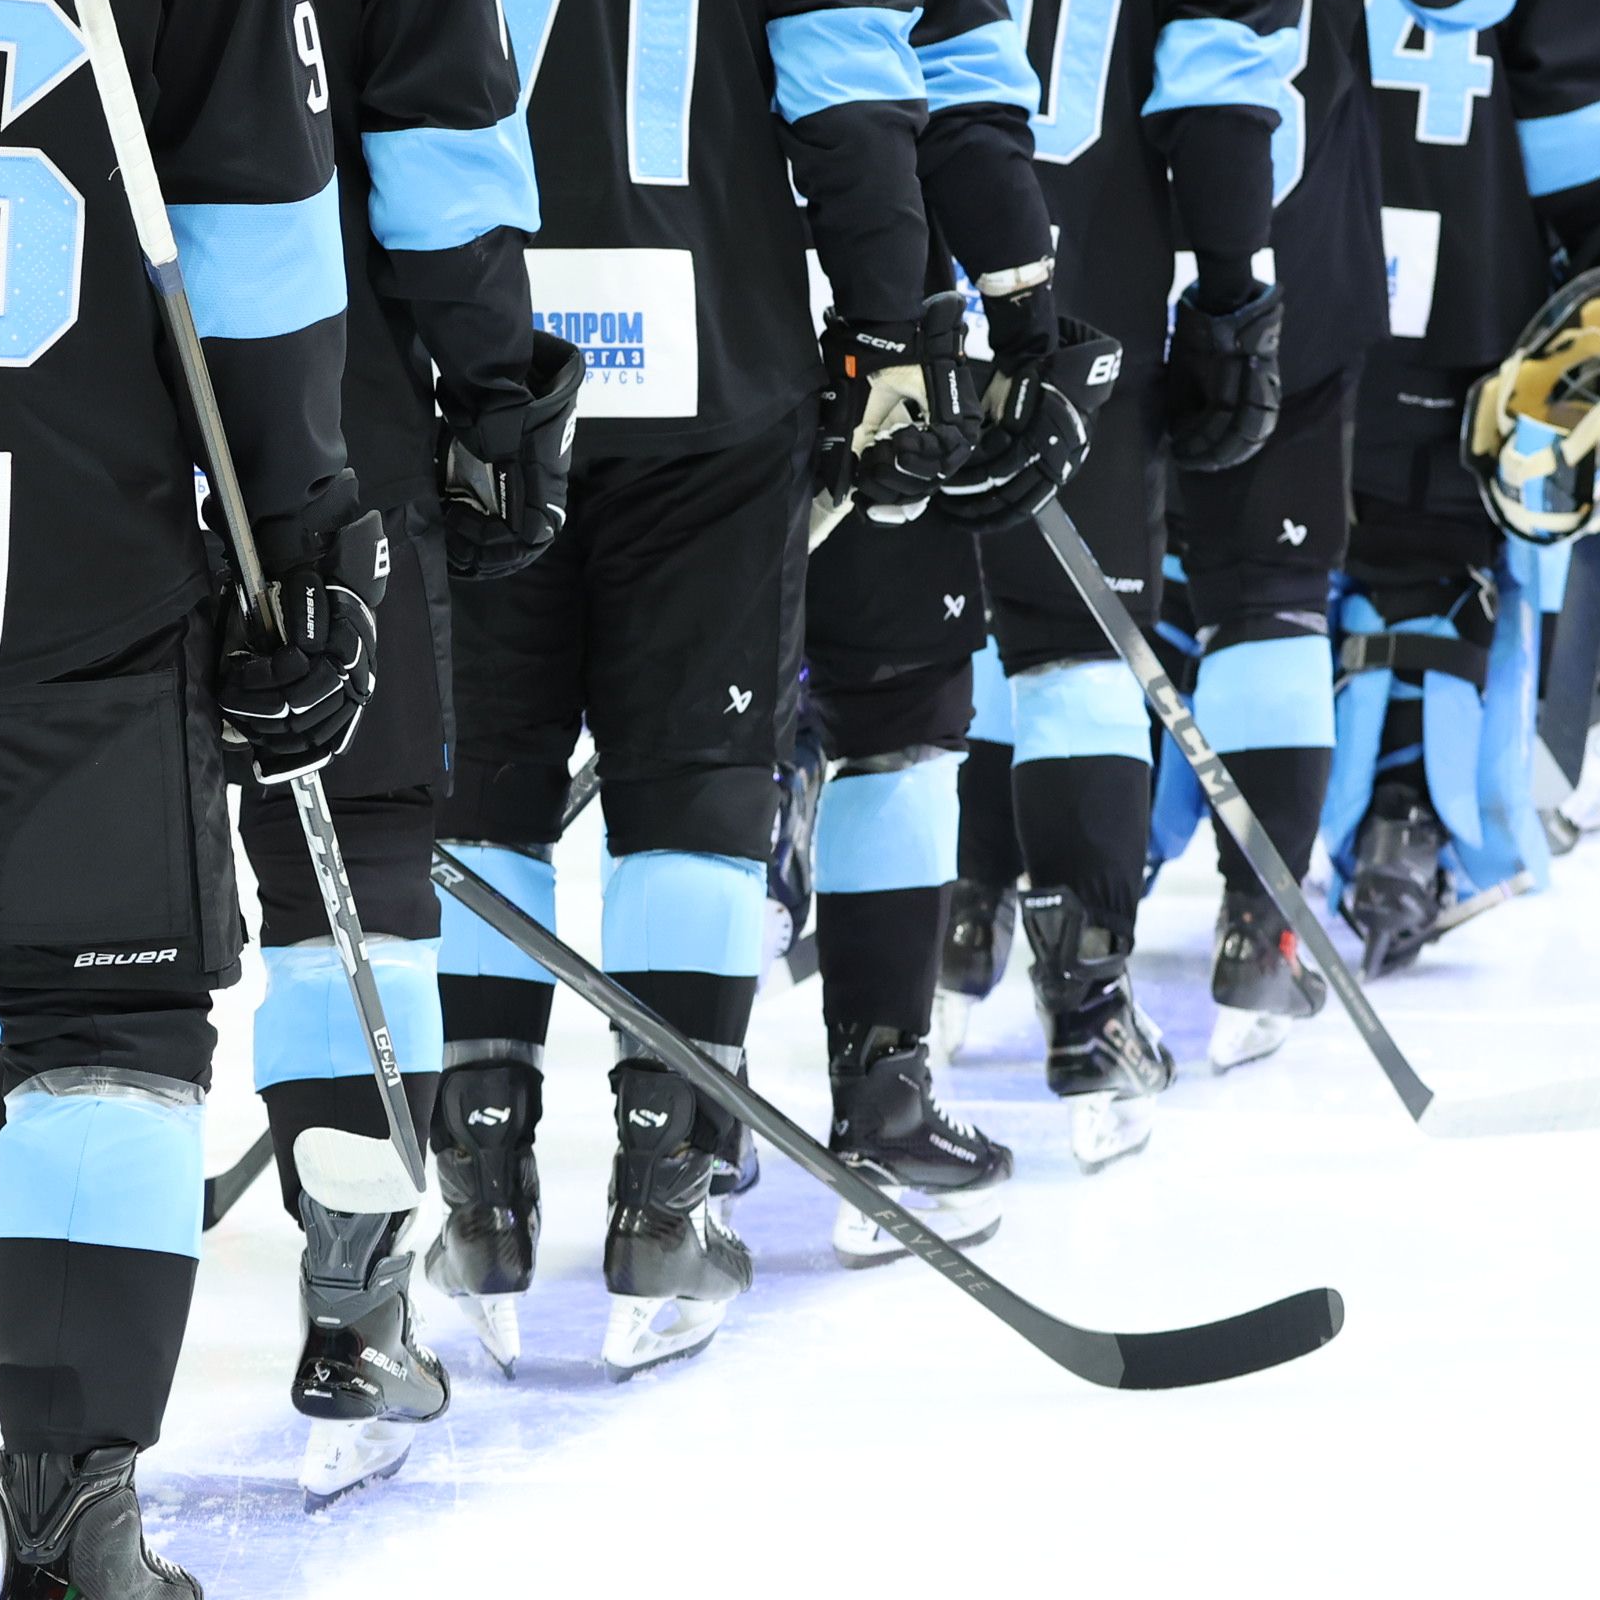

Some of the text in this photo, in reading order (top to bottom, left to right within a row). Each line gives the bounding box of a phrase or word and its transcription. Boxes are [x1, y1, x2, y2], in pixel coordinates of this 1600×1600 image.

[294, 1, 331, 113] 9
[532, 311, 643, 344] АЗПРОМ
[856, 332, 906, 353] CCM
[584, 350, 642, 367] СГАЗ
[586, 370, 644, 385] РУСЬ
[375, 1031, 400, 1083] CCM
[874, 1208, 991, 1292] FLYLITE
